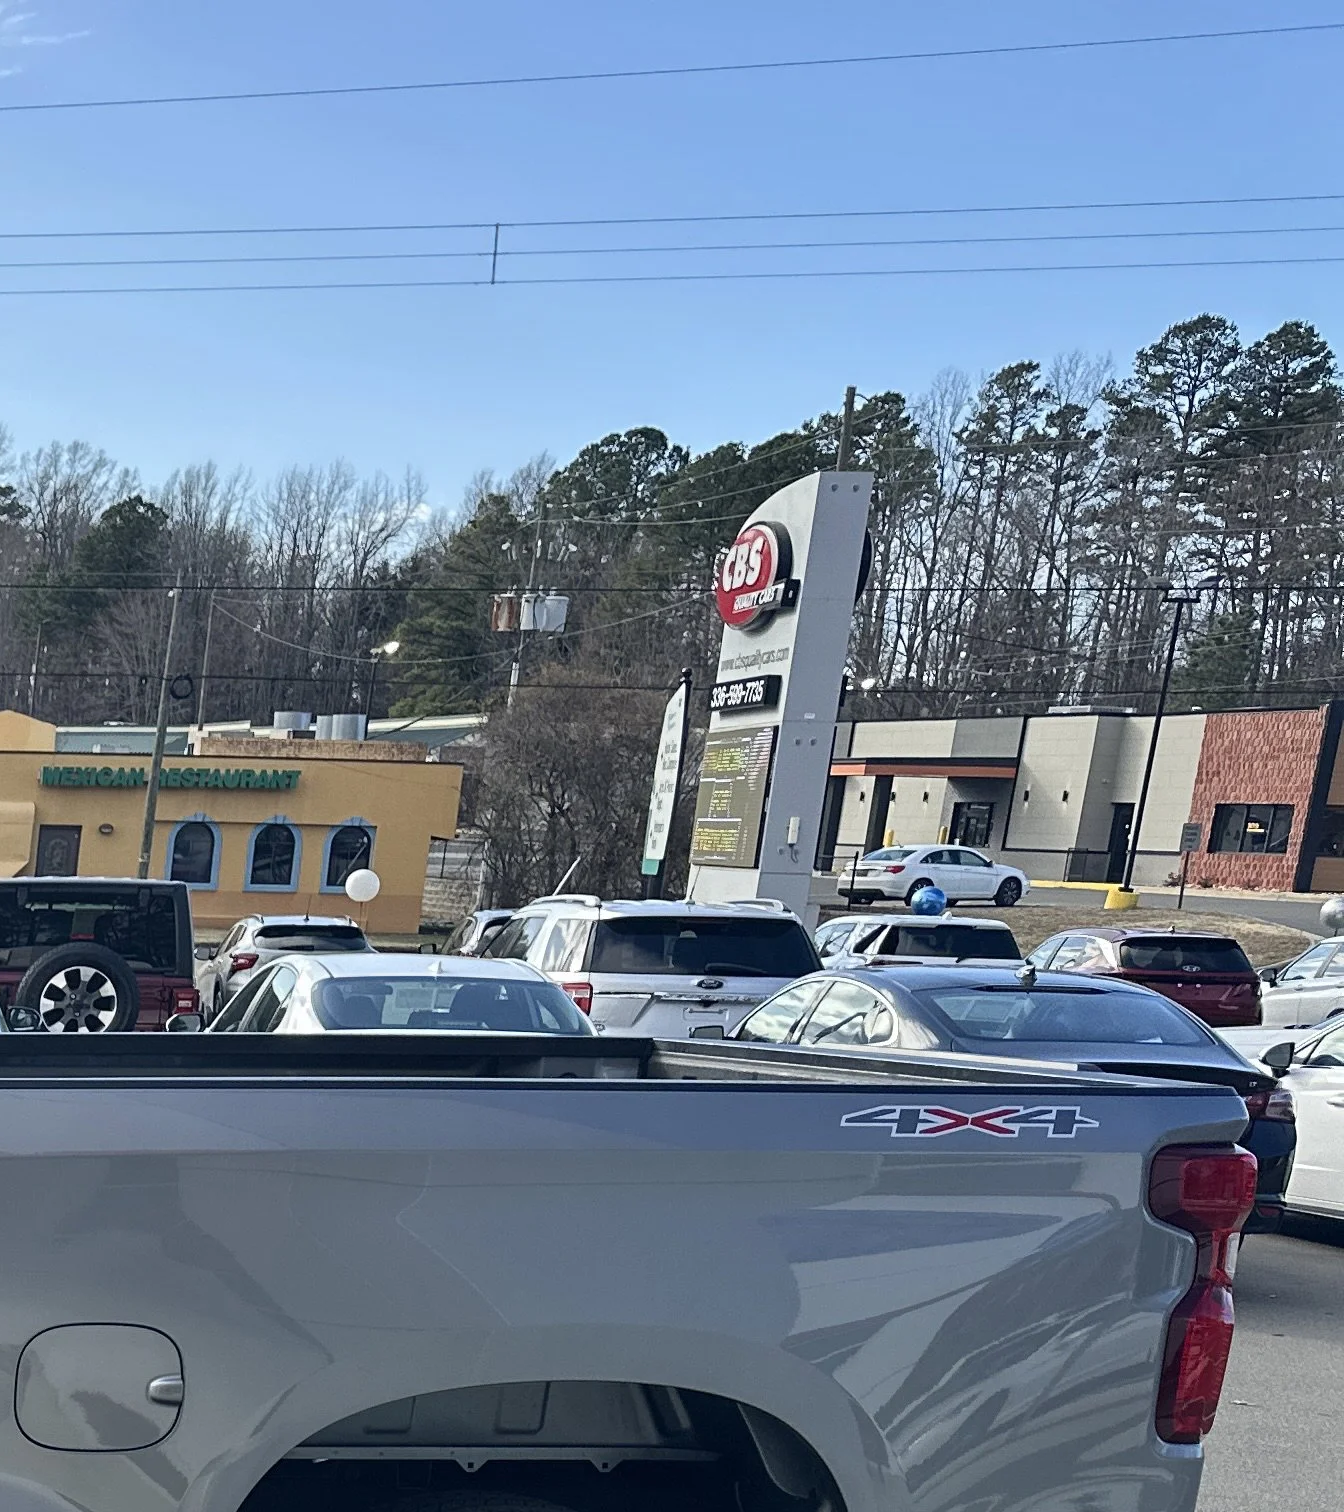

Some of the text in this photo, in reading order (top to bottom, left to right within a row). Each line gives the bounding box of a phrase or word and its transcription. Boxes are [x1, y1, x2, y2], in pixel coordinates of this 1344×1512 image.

[722, 536, 765, 592] CBS
[40, 766, 301, 790] MEXICAN RESTAURANT
[840, 1105, 1099, 1138] 4X4
